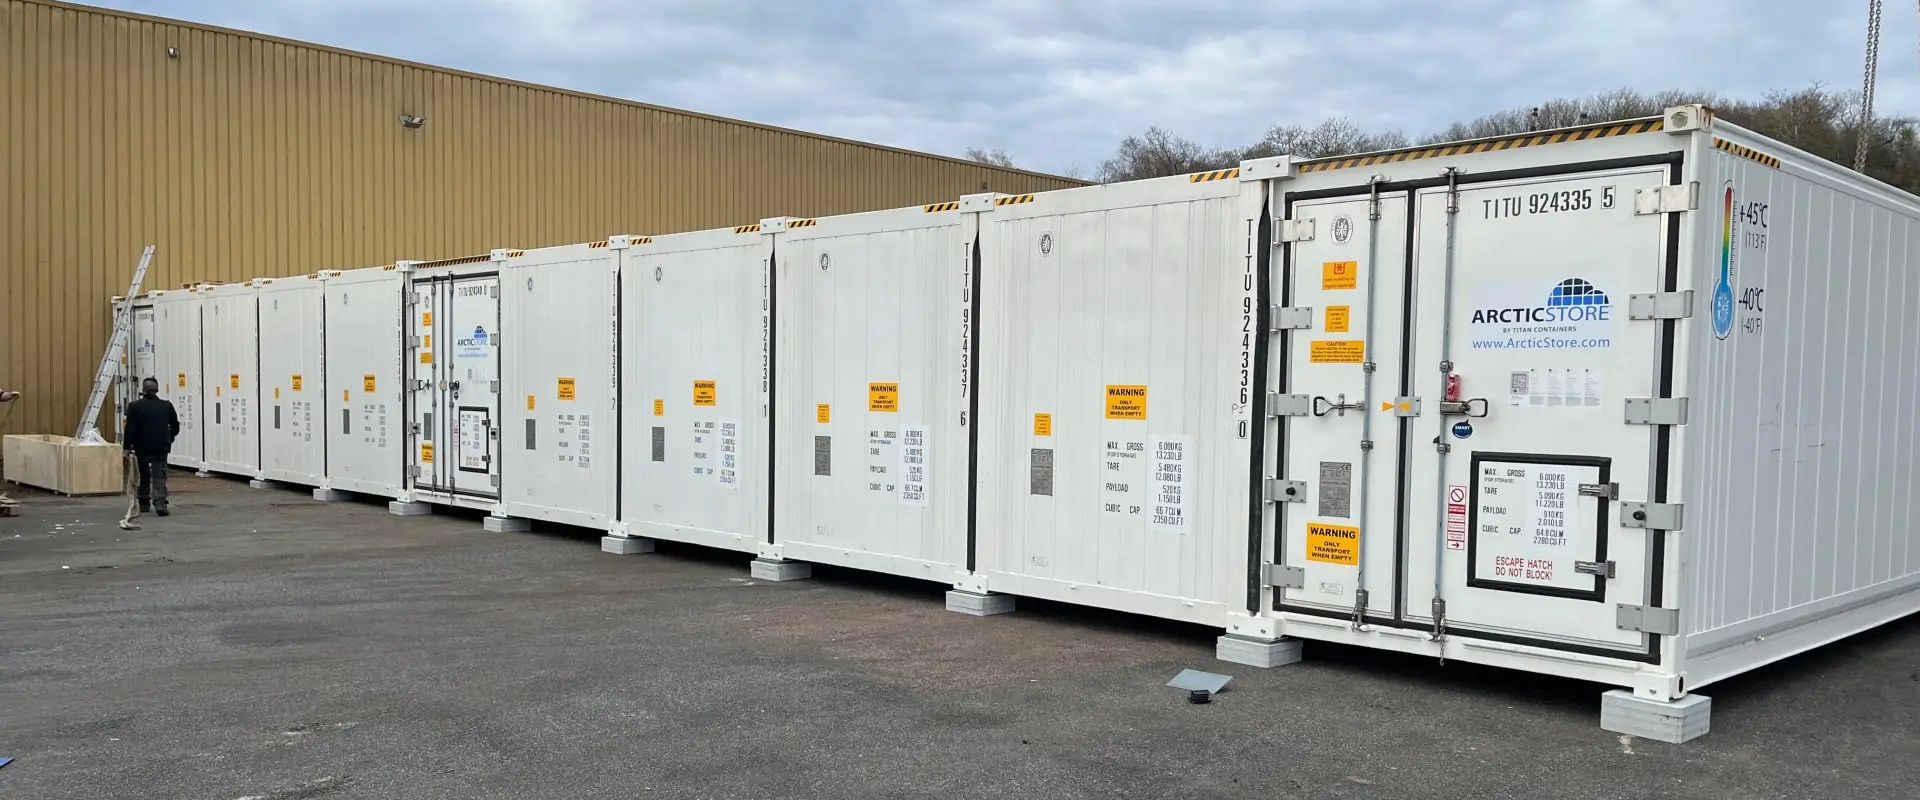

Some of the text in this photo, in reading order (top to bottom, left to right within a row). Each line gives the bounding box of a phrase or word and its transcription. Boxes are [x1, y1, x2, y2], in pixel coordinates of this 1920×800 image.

[1483, 187, 1614, 219] TITU 924335 5
[1244, 218, 1254, 291] TITU
[1472, 306, 1609, 323] ARCTICSTORE
[1473, 337, 1610, 349] www.ArcticStore.com
[1240, 296, 1251, 404] 924336
[1126, 442, 1144, 451] GROSS
[1107, 462, 1119, 471] TARE
[1507, 469, 1525, 477] GROSS
[1106, 483, 1128, 493] PAYLOAD
[1484, 487, 1498, 495] TARE
[1106, 503, 1121, 513] CUBIC
[1483, 506, 1506, 514] PAYLOAD
[1310, 527, 1356, 539] WARNING
[1482, 525, 1523, 536] CUBIC CAP.
[1314, 546, 1350, 555] TRANSPORT
[1496, 556, 1552, 570] ESCAPE HATCH
[1496, 567, 1552, 580] DO NOT BLOCK!
